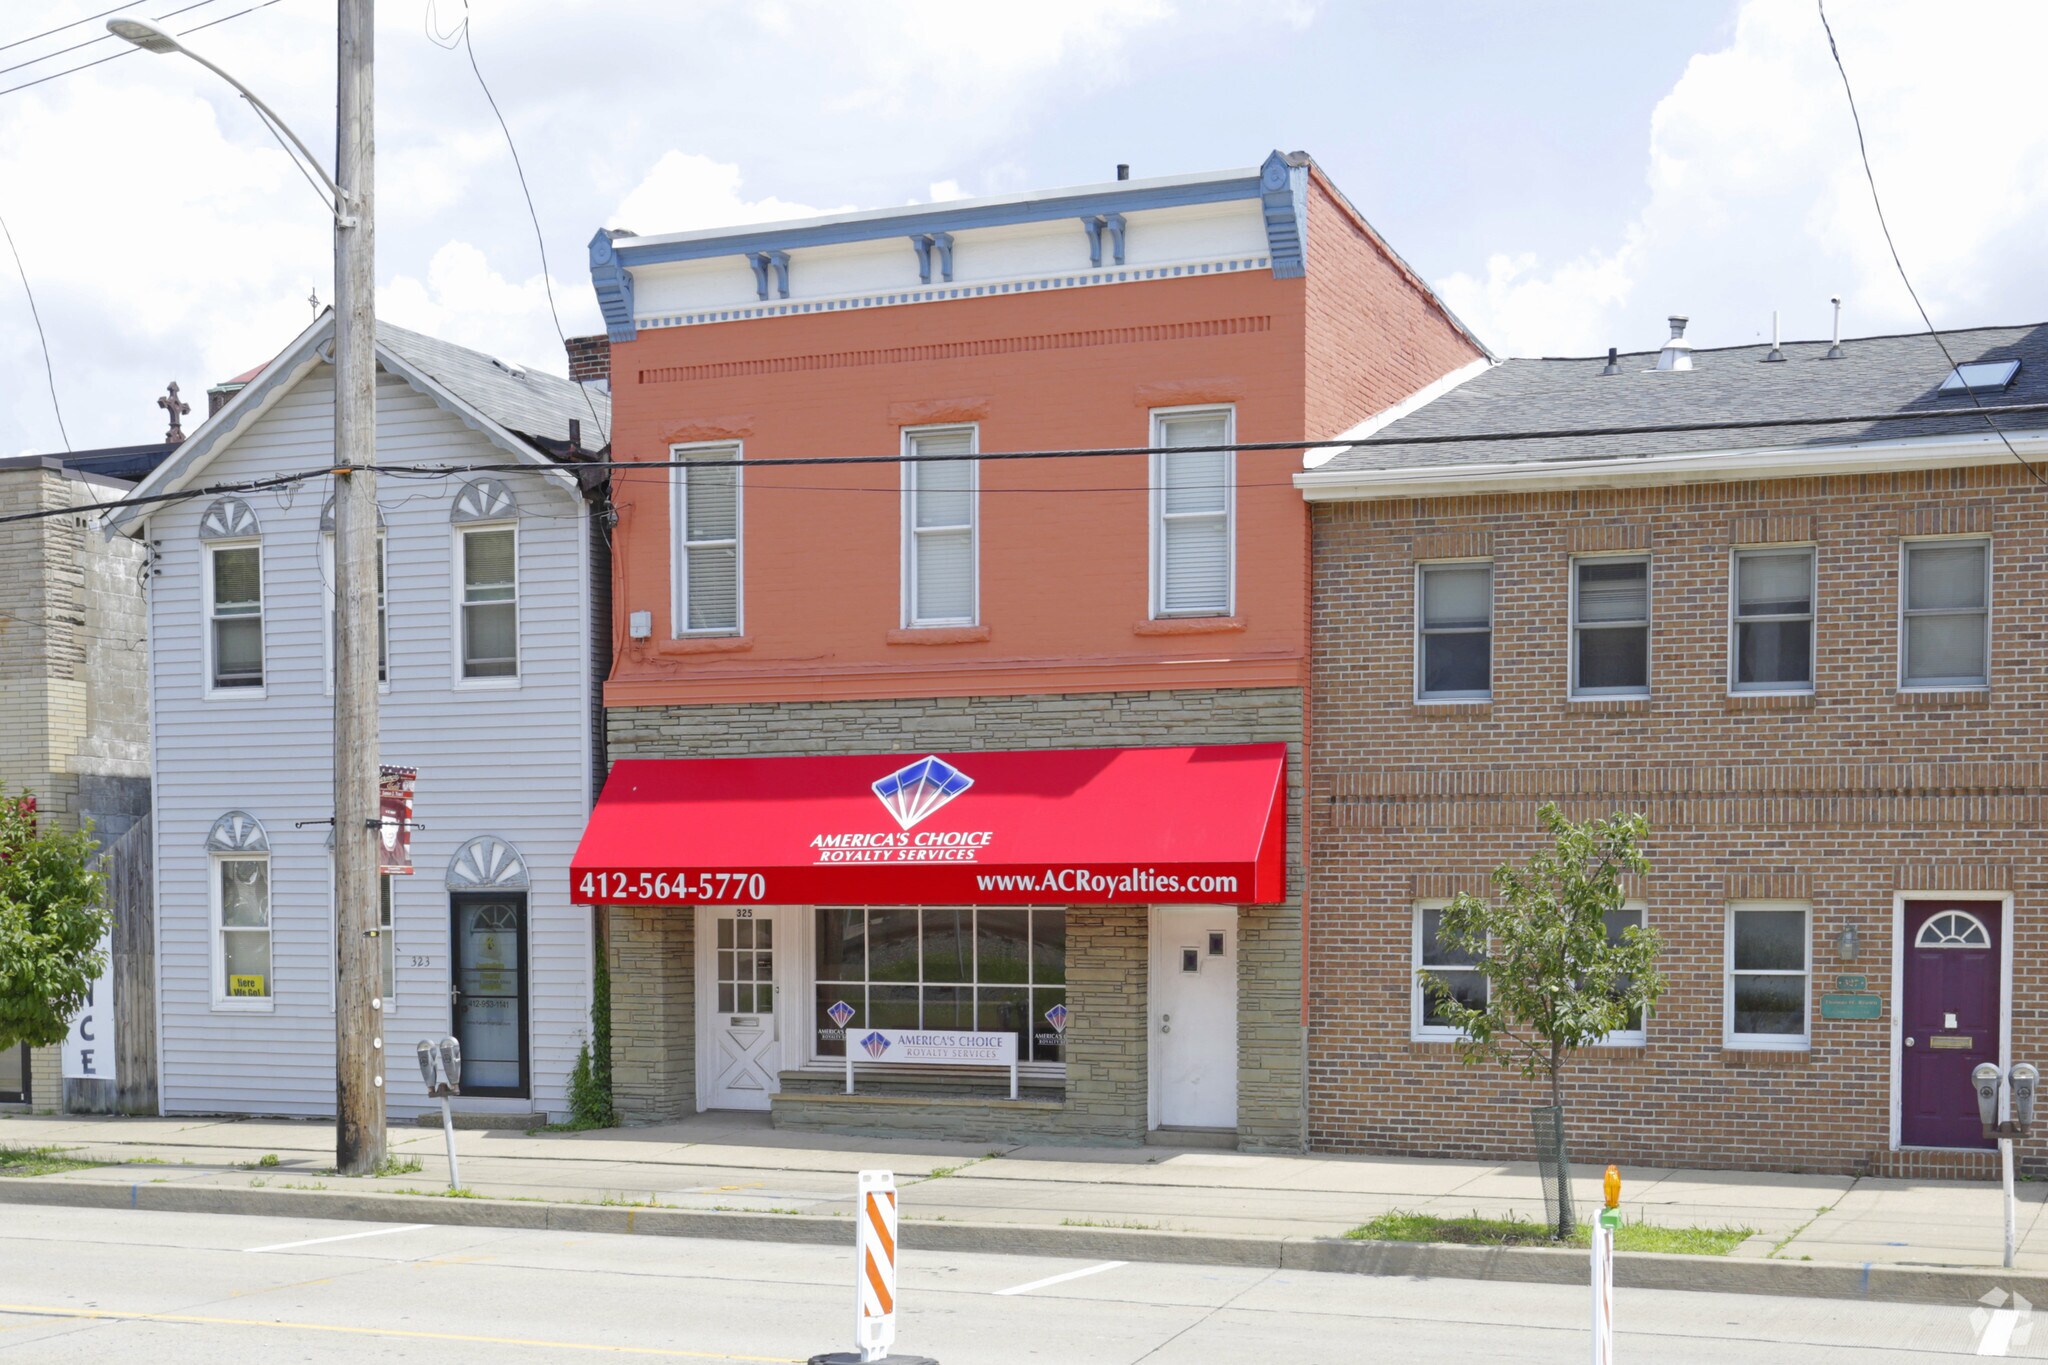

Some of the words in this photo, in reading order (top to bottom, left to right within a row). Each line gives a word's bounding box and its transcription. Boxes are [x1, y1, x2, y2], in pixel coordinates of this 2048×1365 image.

[809, 832, 910, 848] AMERICA'S
[914, 831, 993, 846] CHOICE
[819, 850, 892, 862] ROYALTY
[897, 849, 975, 861] SERVICES
[579, 872, 766, 900] 412-564-5770
[976, 867, 1238, 899] www.ACRoyalties.com
[736, 908, 753, 918] 325
[410, 955, 430, 967] 323
[237, 978, 256, 988] Here
[898, 1035, 956, 1047] AMERICA'S
[960, 1036, 1003, 1048] CHOICE
[906, 1048, 948, 1057] ROYALTY
[952, 1050, 997, 1059] SERVICES
